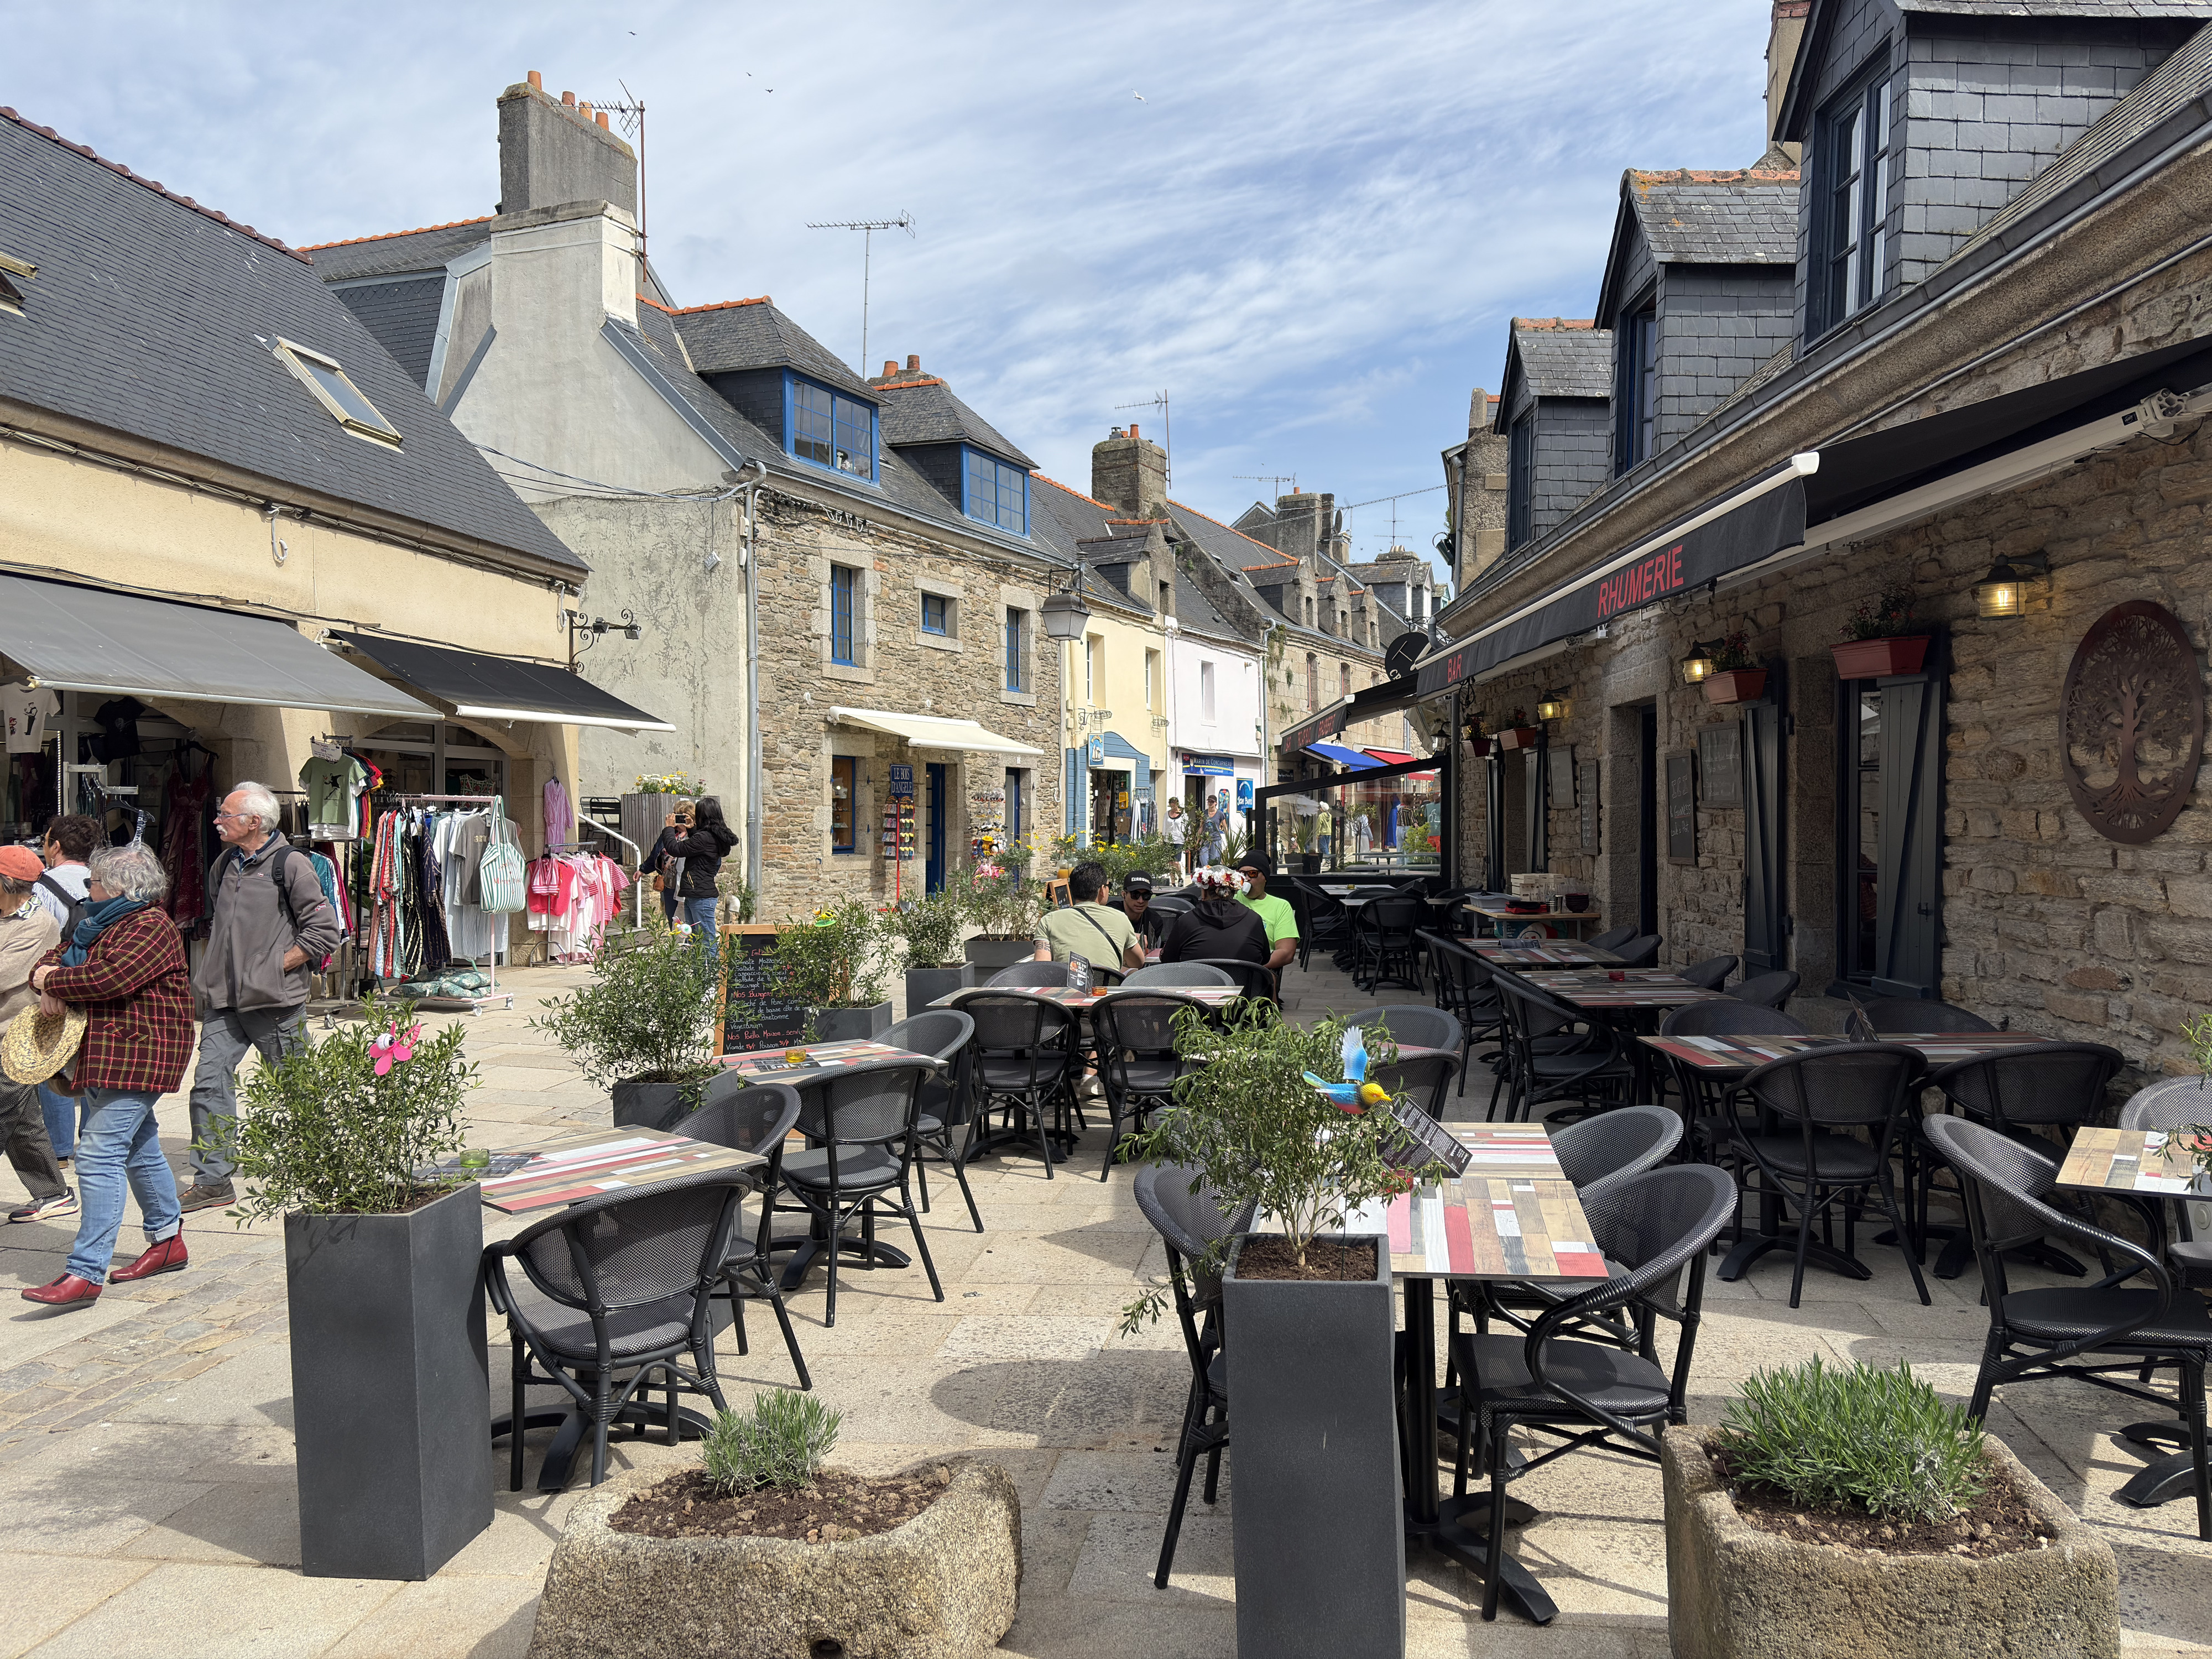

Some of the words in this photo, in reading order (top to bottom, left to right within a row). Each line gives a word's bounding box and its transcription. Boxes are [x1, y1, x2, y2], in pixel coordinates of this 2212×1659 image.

[1598, 545, 1683, 618] RHUMERIE
[1447, 654, 1462, 683] BAR
[894, 768, 900, 780] LE
[900, 768, 910, 780] BOIS
[891, 781, 912, 794] D'ANGELE
[751, 948, 773, 956] Entr
[733, 990, 746, 998] Nos
[727, 1031, 740, 1041] Nos
[763, 1029, 781, 1039] Maison
[726, 1042, 745, 1050] Viande
[759, 1040, 779, 1050] Poisson
